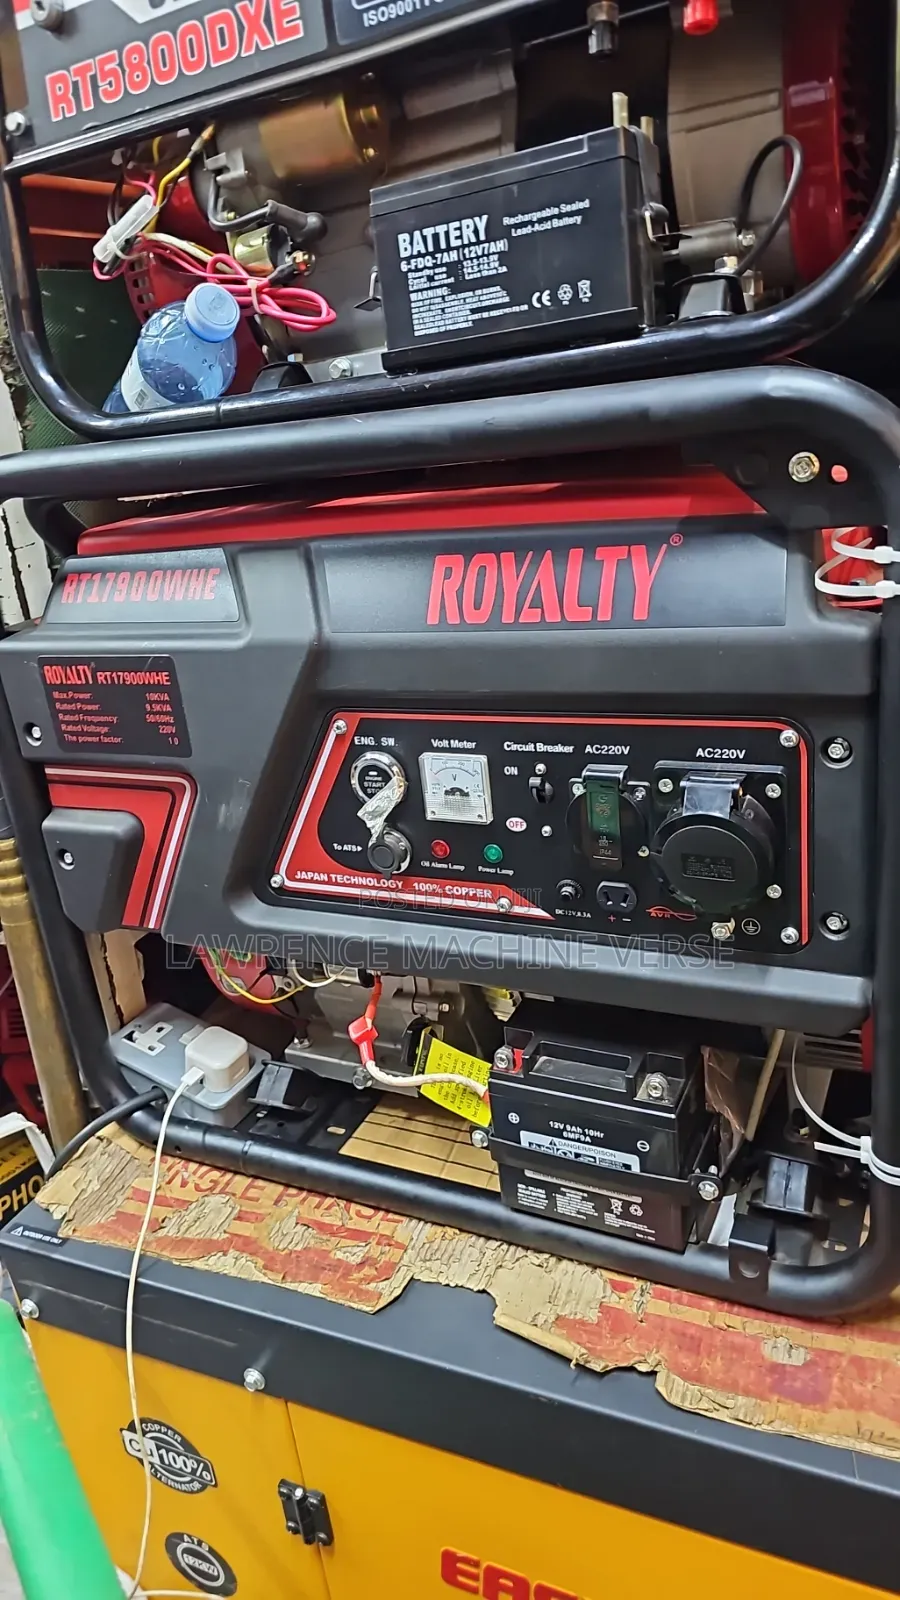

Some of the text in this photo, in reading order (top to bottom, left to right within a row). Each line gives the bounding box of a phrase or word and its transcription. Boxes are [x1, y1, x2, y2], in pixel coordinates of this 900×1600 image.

[45, 0, 304, 122] RT5800DXE
[502, 198, 590, 226] Rechargeable Sealed
[511, 216, 582, 237] Lead-Acid Battery
[398, 214, 489, 259] BATTERY
[400, 240, 509, 272] 6-FDQ-7AH (12V7AH)
[409, 287, 452, 301] WARNING:
[61, 567, 220, 604] RT17900WHE
[427, 543, 667, 625] ROYALTY
[43, 665, 171, 685] ROYALTY RT17900WHE
[55, 702, 76, 711] Rated
[58, 713, 79, 722] Rated
[61, 724, 81, 733] Rated
[64, 734, 77, 743] The
[77, 735, 100, 744] power
[354, 735, 399, 748] ENG. SW.
[431, 738, 477, 749] Volt Meter
[503, 741, 575, 753] Circuit Breaker
[584, 744, 631, 755] AC220V
[695, 747, 746, 759] AC220V
[504, 766, 518, 776] ON
[508, 820, 525, 829] OFF
[333, 843, 357, 852] To ATS
[431, 861, 448, 869] Alarm
[448, 863, 465, 872] Lamp
[477, 865, 514, 877] Power Lamp
[295, 870, 492, 898] JAPAN TECHNOLOGY 100% COPPER
[650, 911, 671, 919] AVR
[549, 1120, 605, 1139] 12V 9Ah 10Hr
[562, 1131, 592, 1143] 6MF9A
[142, 1422, 182, 1443] COPPER
[158, 1448, 212, 1481] 100%
[148, 1464, 203, 1493] LTERNATOR
